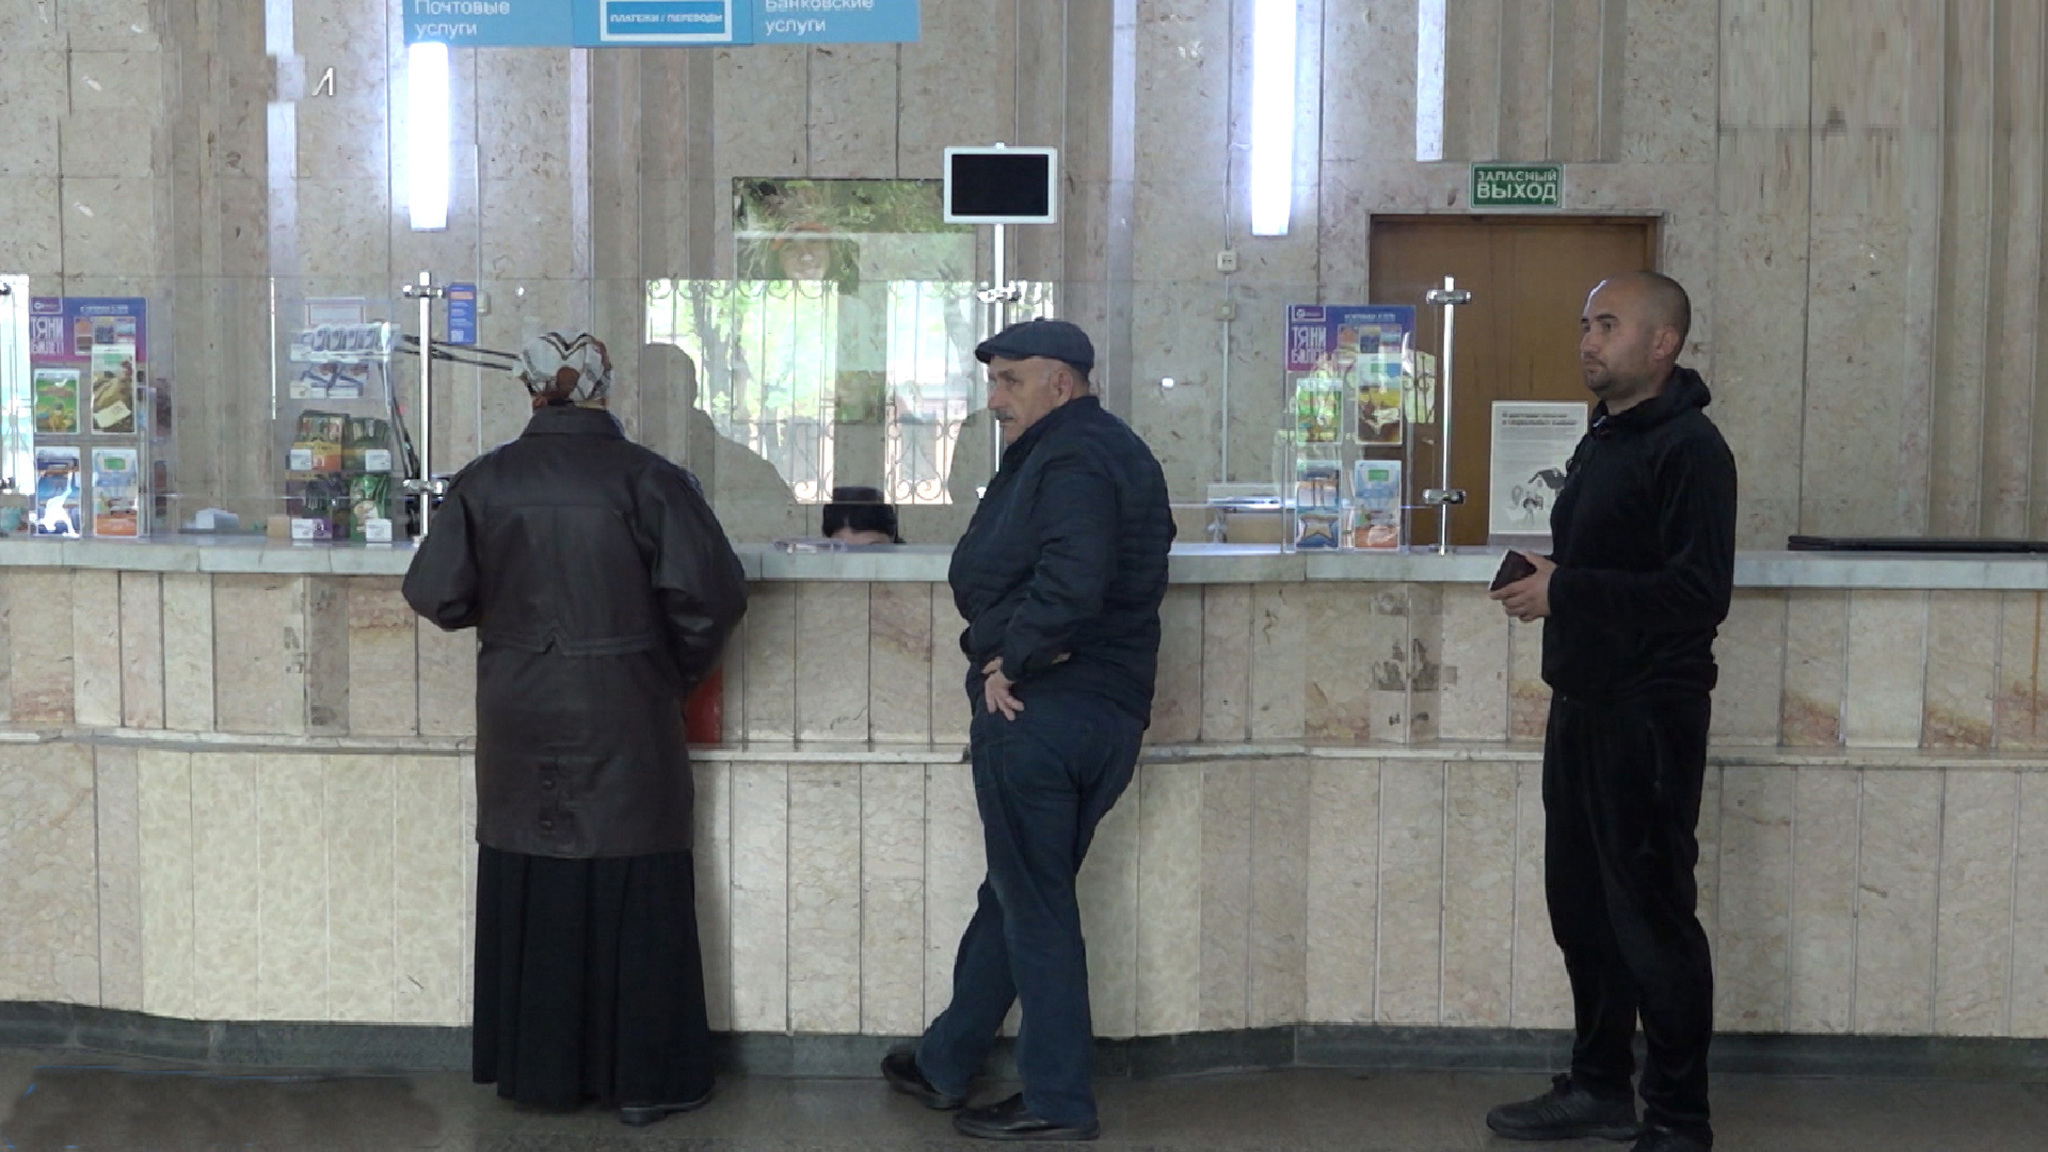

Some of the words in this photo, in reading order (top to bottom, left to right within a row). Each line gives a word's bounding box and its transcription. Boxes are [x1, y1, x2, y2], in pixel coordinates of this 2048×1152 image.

[414, 0, 511, 15] Почтовые
[765, 0, 875, 11] Банковские
[610, 14, 660, 23] ПЛАТЕЖИ
[765, 18, 827, 36] услуги
[414, 23, 478, 40] услуги
[1477, 169, 1557, 181] ЗАПАСНЫЙ
[1477, 183, 1557, 202] ВЫХОД
[30, 316, 64, 338] ТЯНИ
[1291, 325, 1327, 347] ТЯНИ
